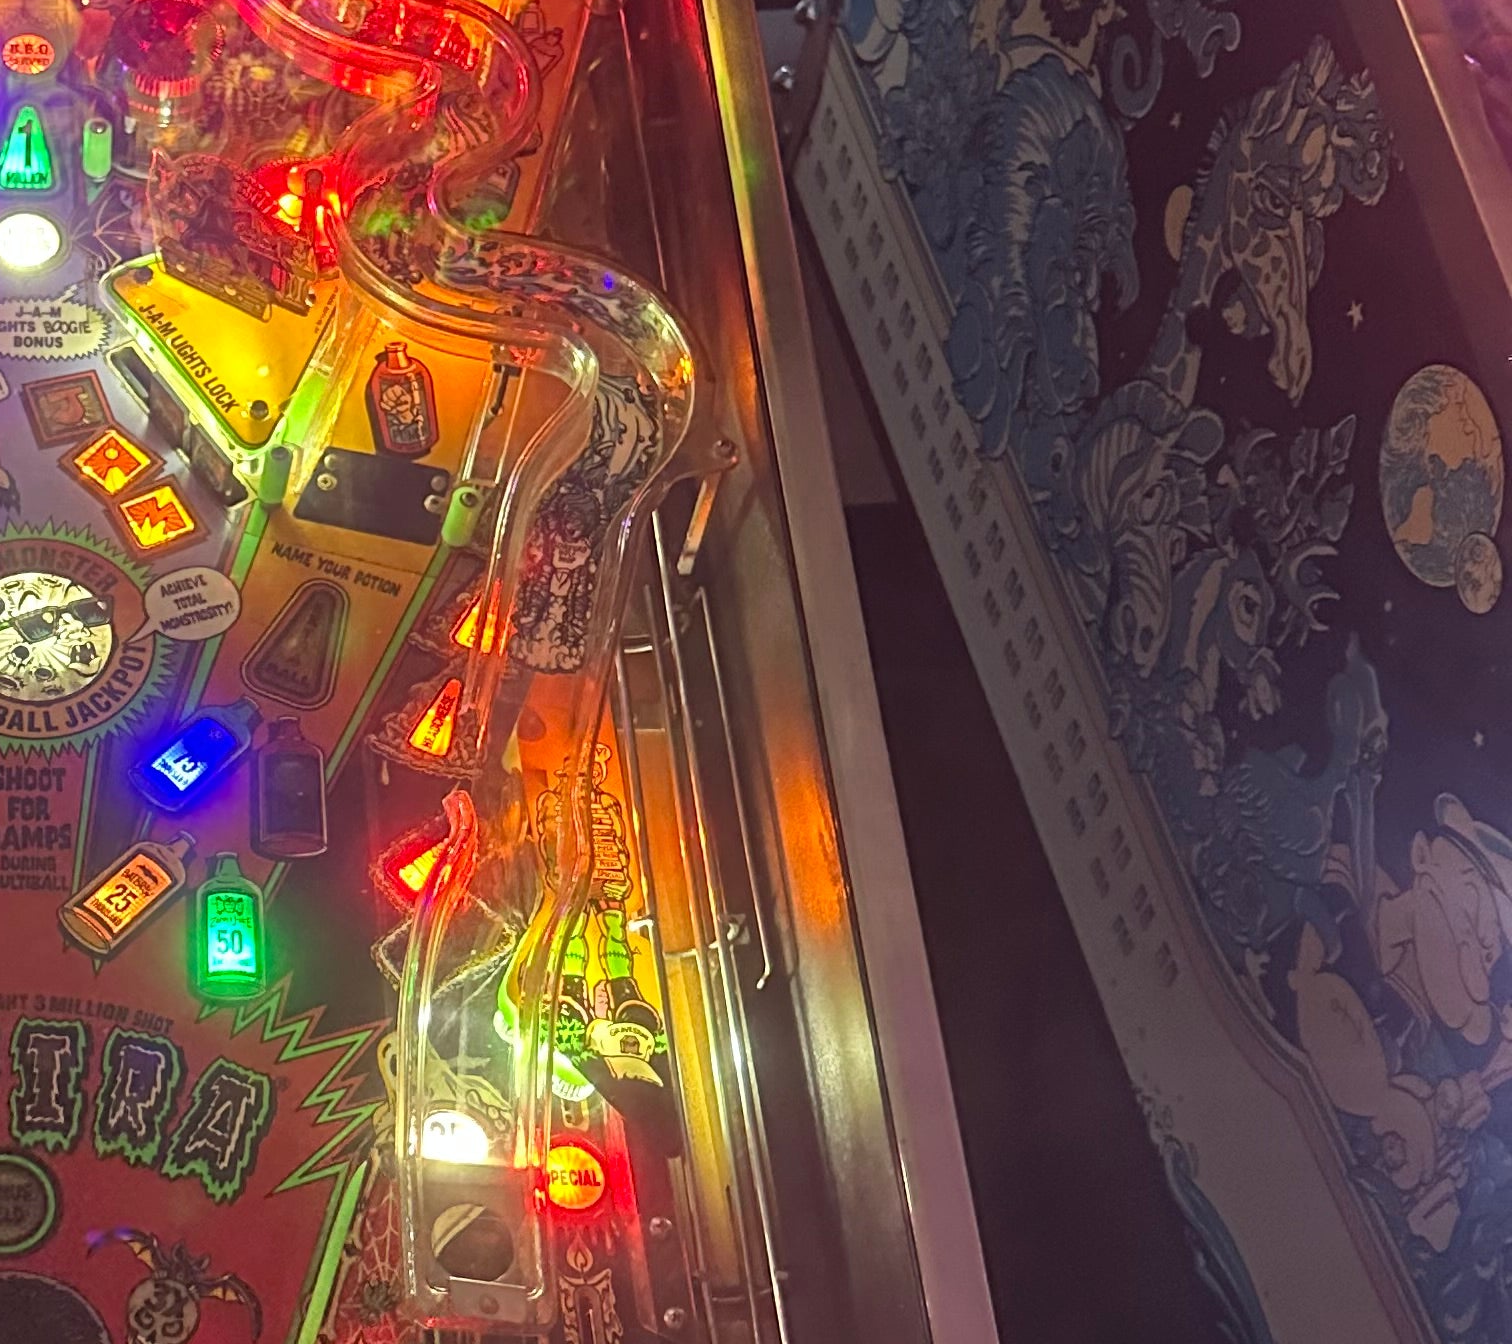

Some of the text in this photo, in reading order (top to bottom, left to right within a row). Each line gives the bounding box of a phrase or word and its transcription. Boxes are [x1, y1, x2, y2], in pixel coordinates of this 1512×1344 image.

[43, 320, 92, 334] BOOGIE
[13, 335, 63, 348] BONUS
[170, 333, 212, 380] LIGHTS
[203, 375, 240, 414] LOCK
[271, 541, 402, 598] NAME YOUR POTION
[173, 592, 208, 610] TOTAL
[64, 642, 147, 729] JACKPOT
[7, 795, 50, 821] FOR
[0, 854, 56, 873] DURING
[103, 883, 138, 914] 25
[216, 929, 243, 955] 50
[33, 993, 47, 1012] 3
[48, 994, 130, 1024] MILLION
[133, 1008, 175, 1034] SHOT
